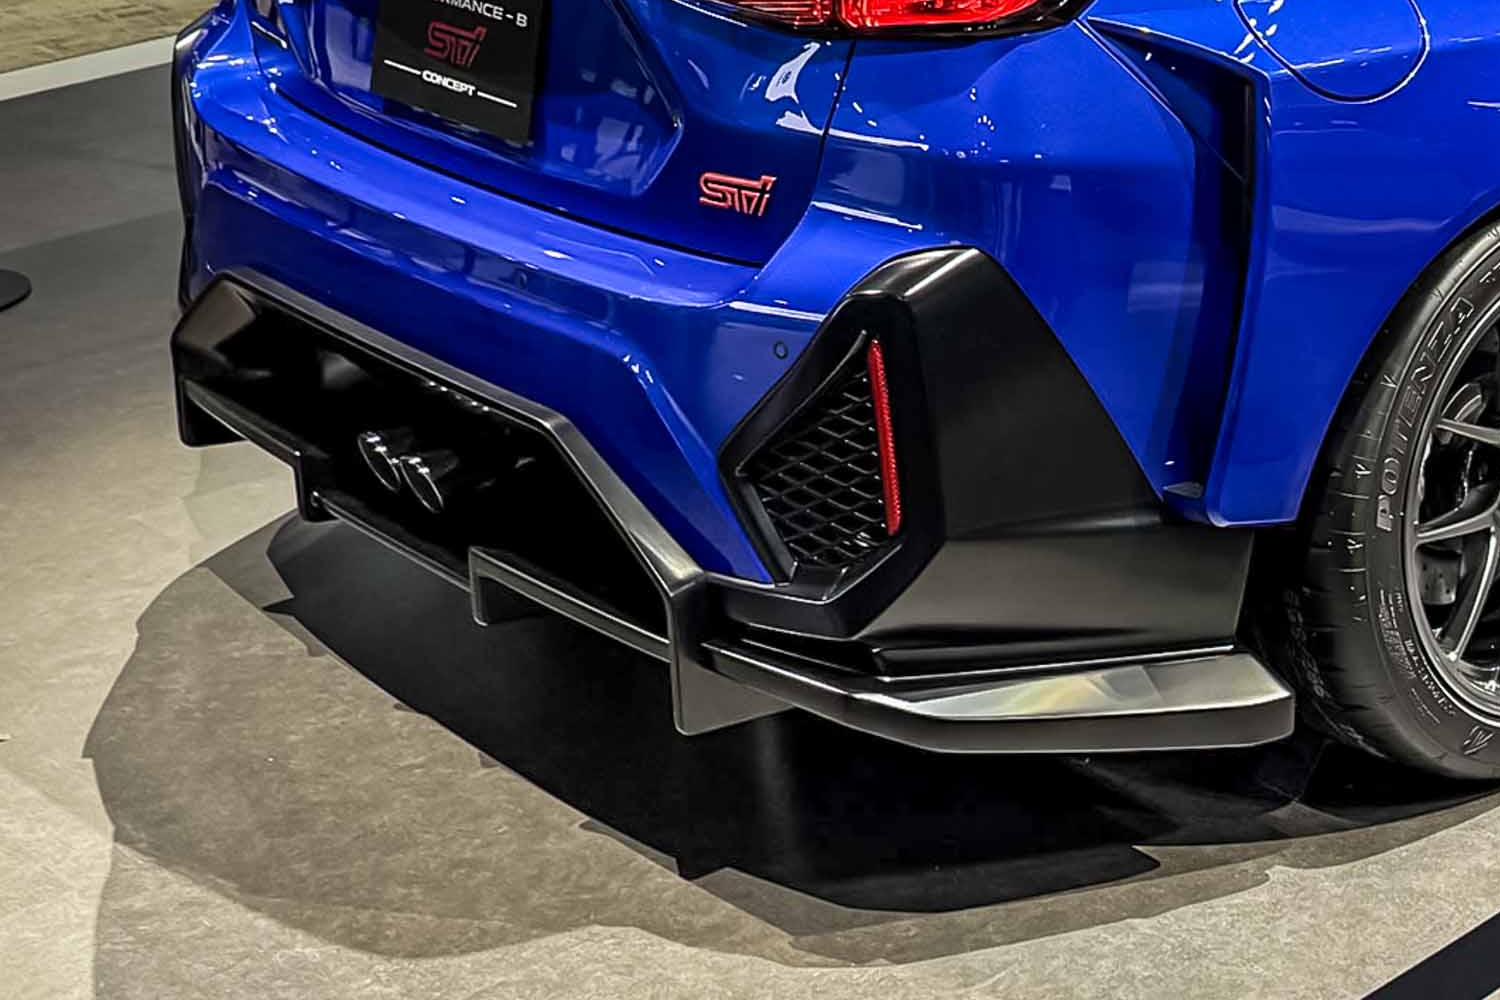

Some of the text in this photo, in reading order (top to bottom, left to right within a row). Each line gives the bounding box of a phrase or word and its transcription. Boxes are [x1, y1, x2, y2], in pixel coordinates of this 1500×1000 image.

[515, 12, 529, 28] B
[421, 70, 476, 97] CONCEPT
[1376, 296, 1475, 532] POTENZA
